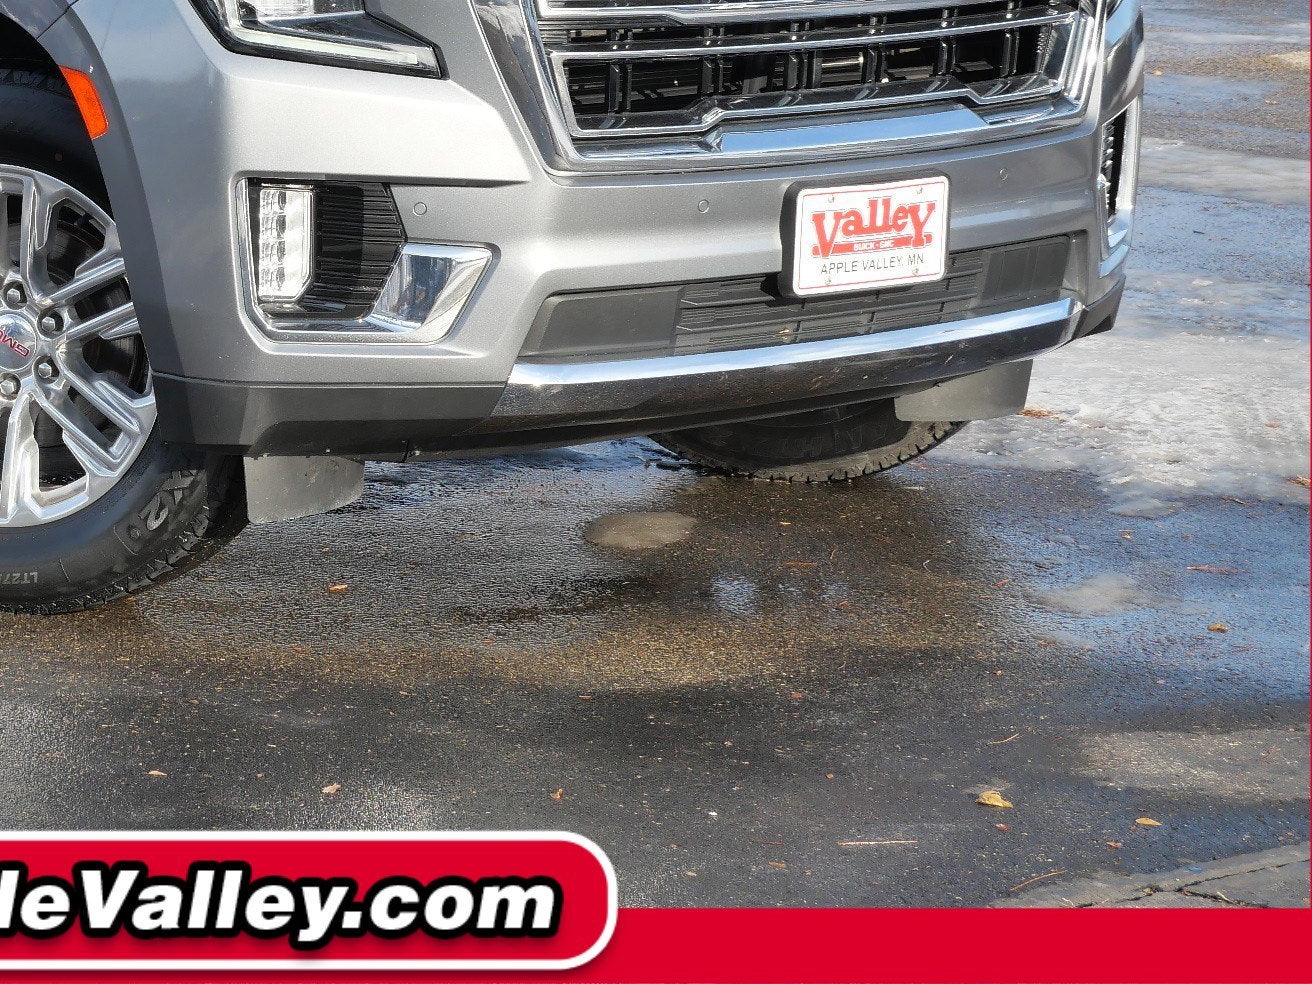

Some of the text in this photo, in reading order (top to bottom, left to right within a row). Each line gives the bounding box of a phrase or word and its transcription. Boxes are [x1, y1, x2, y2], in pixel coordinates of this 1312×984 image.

[812, 198, 936, 258] Valley
[821, 260, 858, 274] APPLE
[907, 253, 924, 265] MN
